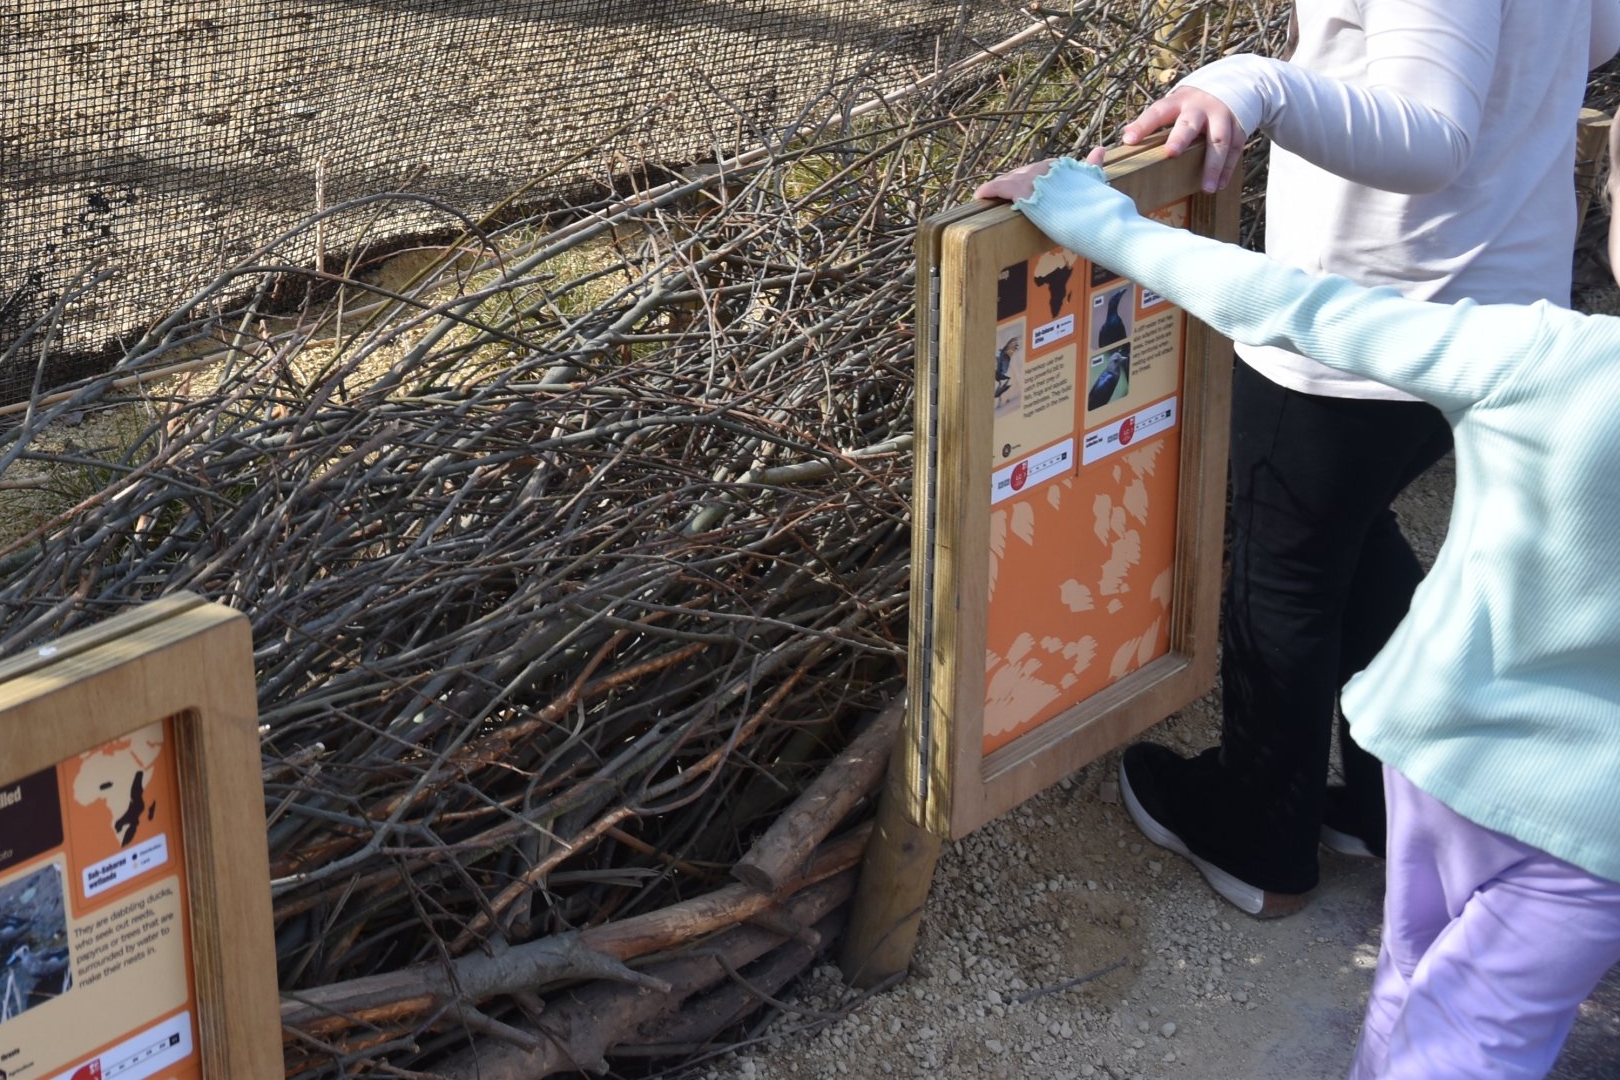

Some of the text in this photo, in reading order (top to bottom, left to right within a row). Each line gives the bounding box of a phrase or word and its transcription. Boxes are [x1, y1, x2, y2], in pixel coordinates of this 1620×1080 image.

[74, 888, 173, 938] They are dabbling ducks,
[75, 938, 94, 952] who
[95, 927, 113, 942] seek
[115, 919, 130, 932] out
[76, 912, 174, 966] papyrus or trees that are
[78, 927, 170, 976] surrounded by water to
[79, 972, 102, 988] make
[103, 961, 121, 977] their
[123, 951, 146, 967] nests
